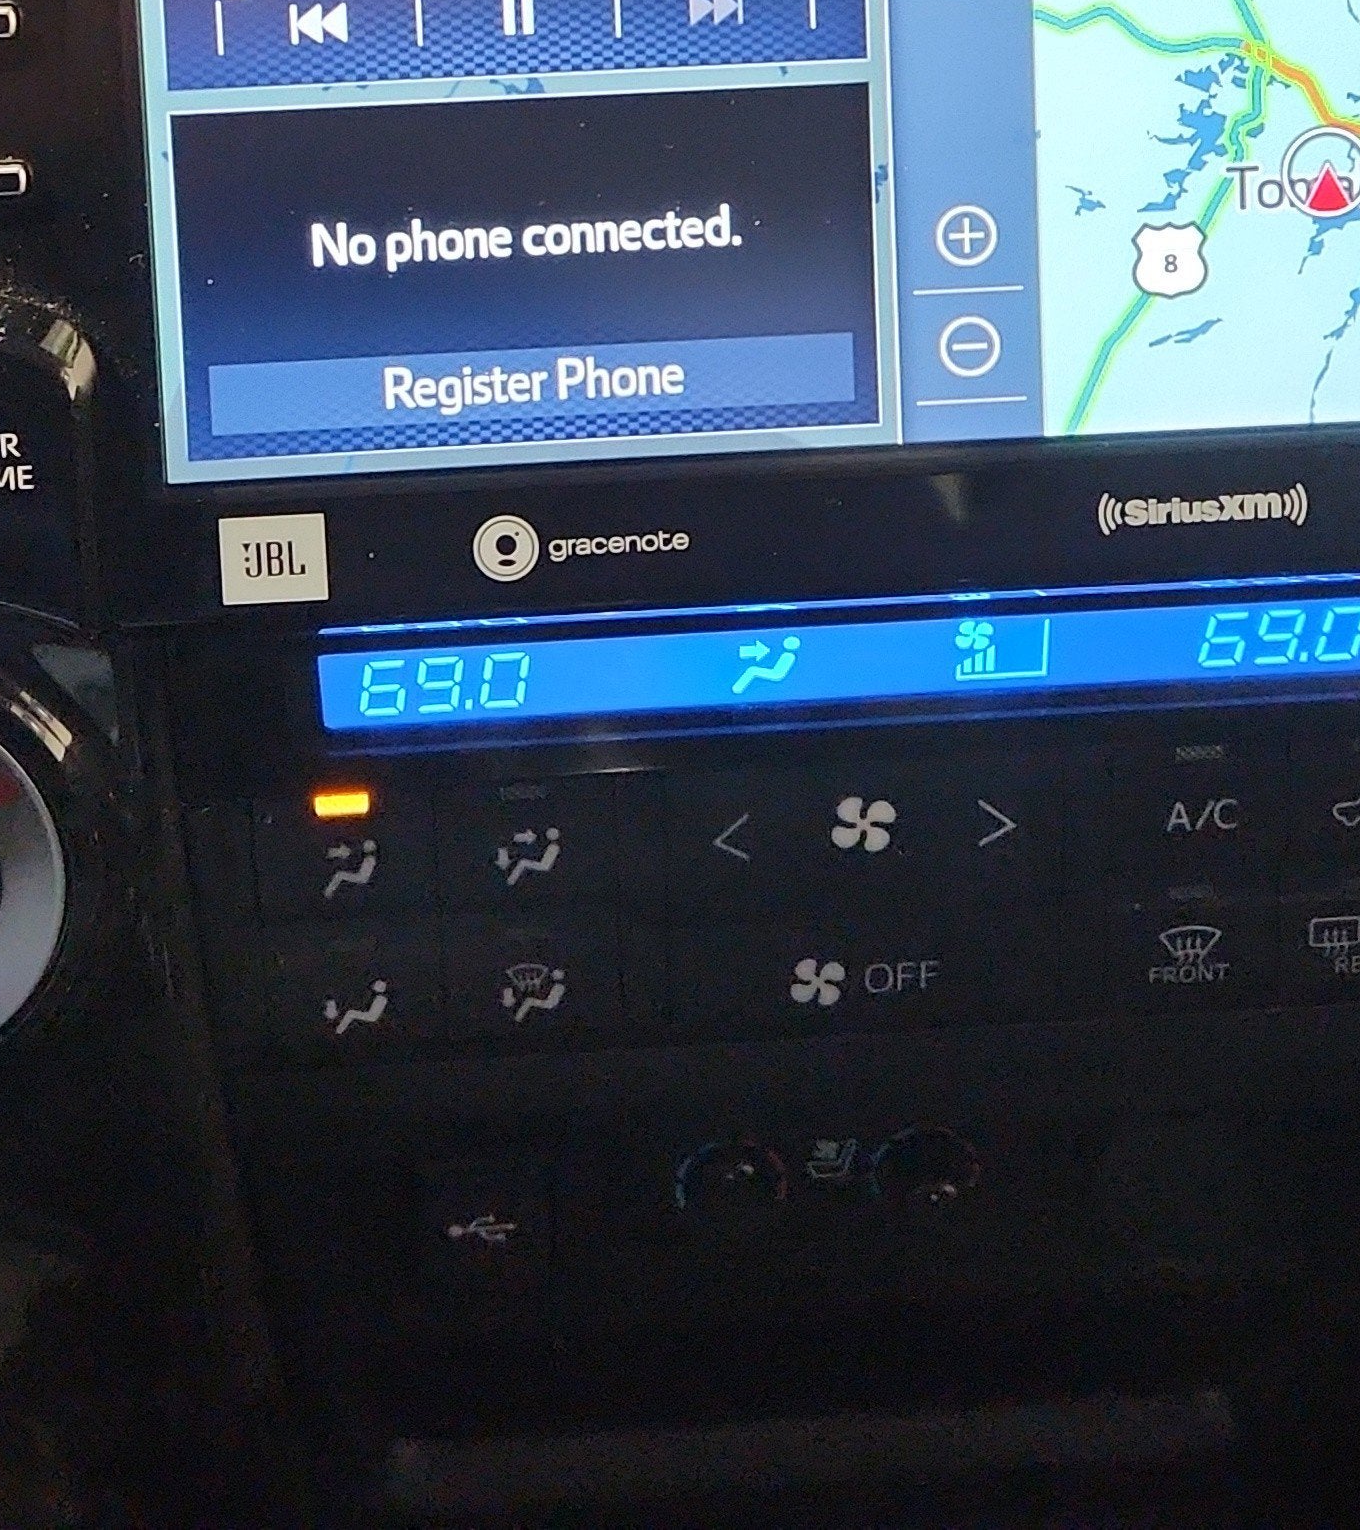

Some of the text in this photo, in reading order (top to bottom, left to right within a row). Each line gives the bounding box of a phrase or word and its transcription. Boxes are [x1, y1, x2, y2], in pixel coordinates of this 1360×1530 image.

[310, 203, 742, 272] No phone connected.
[1164, 253, 1178, 275] 8
[383, 357, 684, 417] Register Phone
[242, 539, 307, 579] JBL
[548, 527, 690, 563] gracenote
[359, 651, 531, 717] 69.0
[1167, 798, 1238, 833] A/C
[865, 960, 940, 994] OFF
[1149, 962, 1230, 984] FRONT
